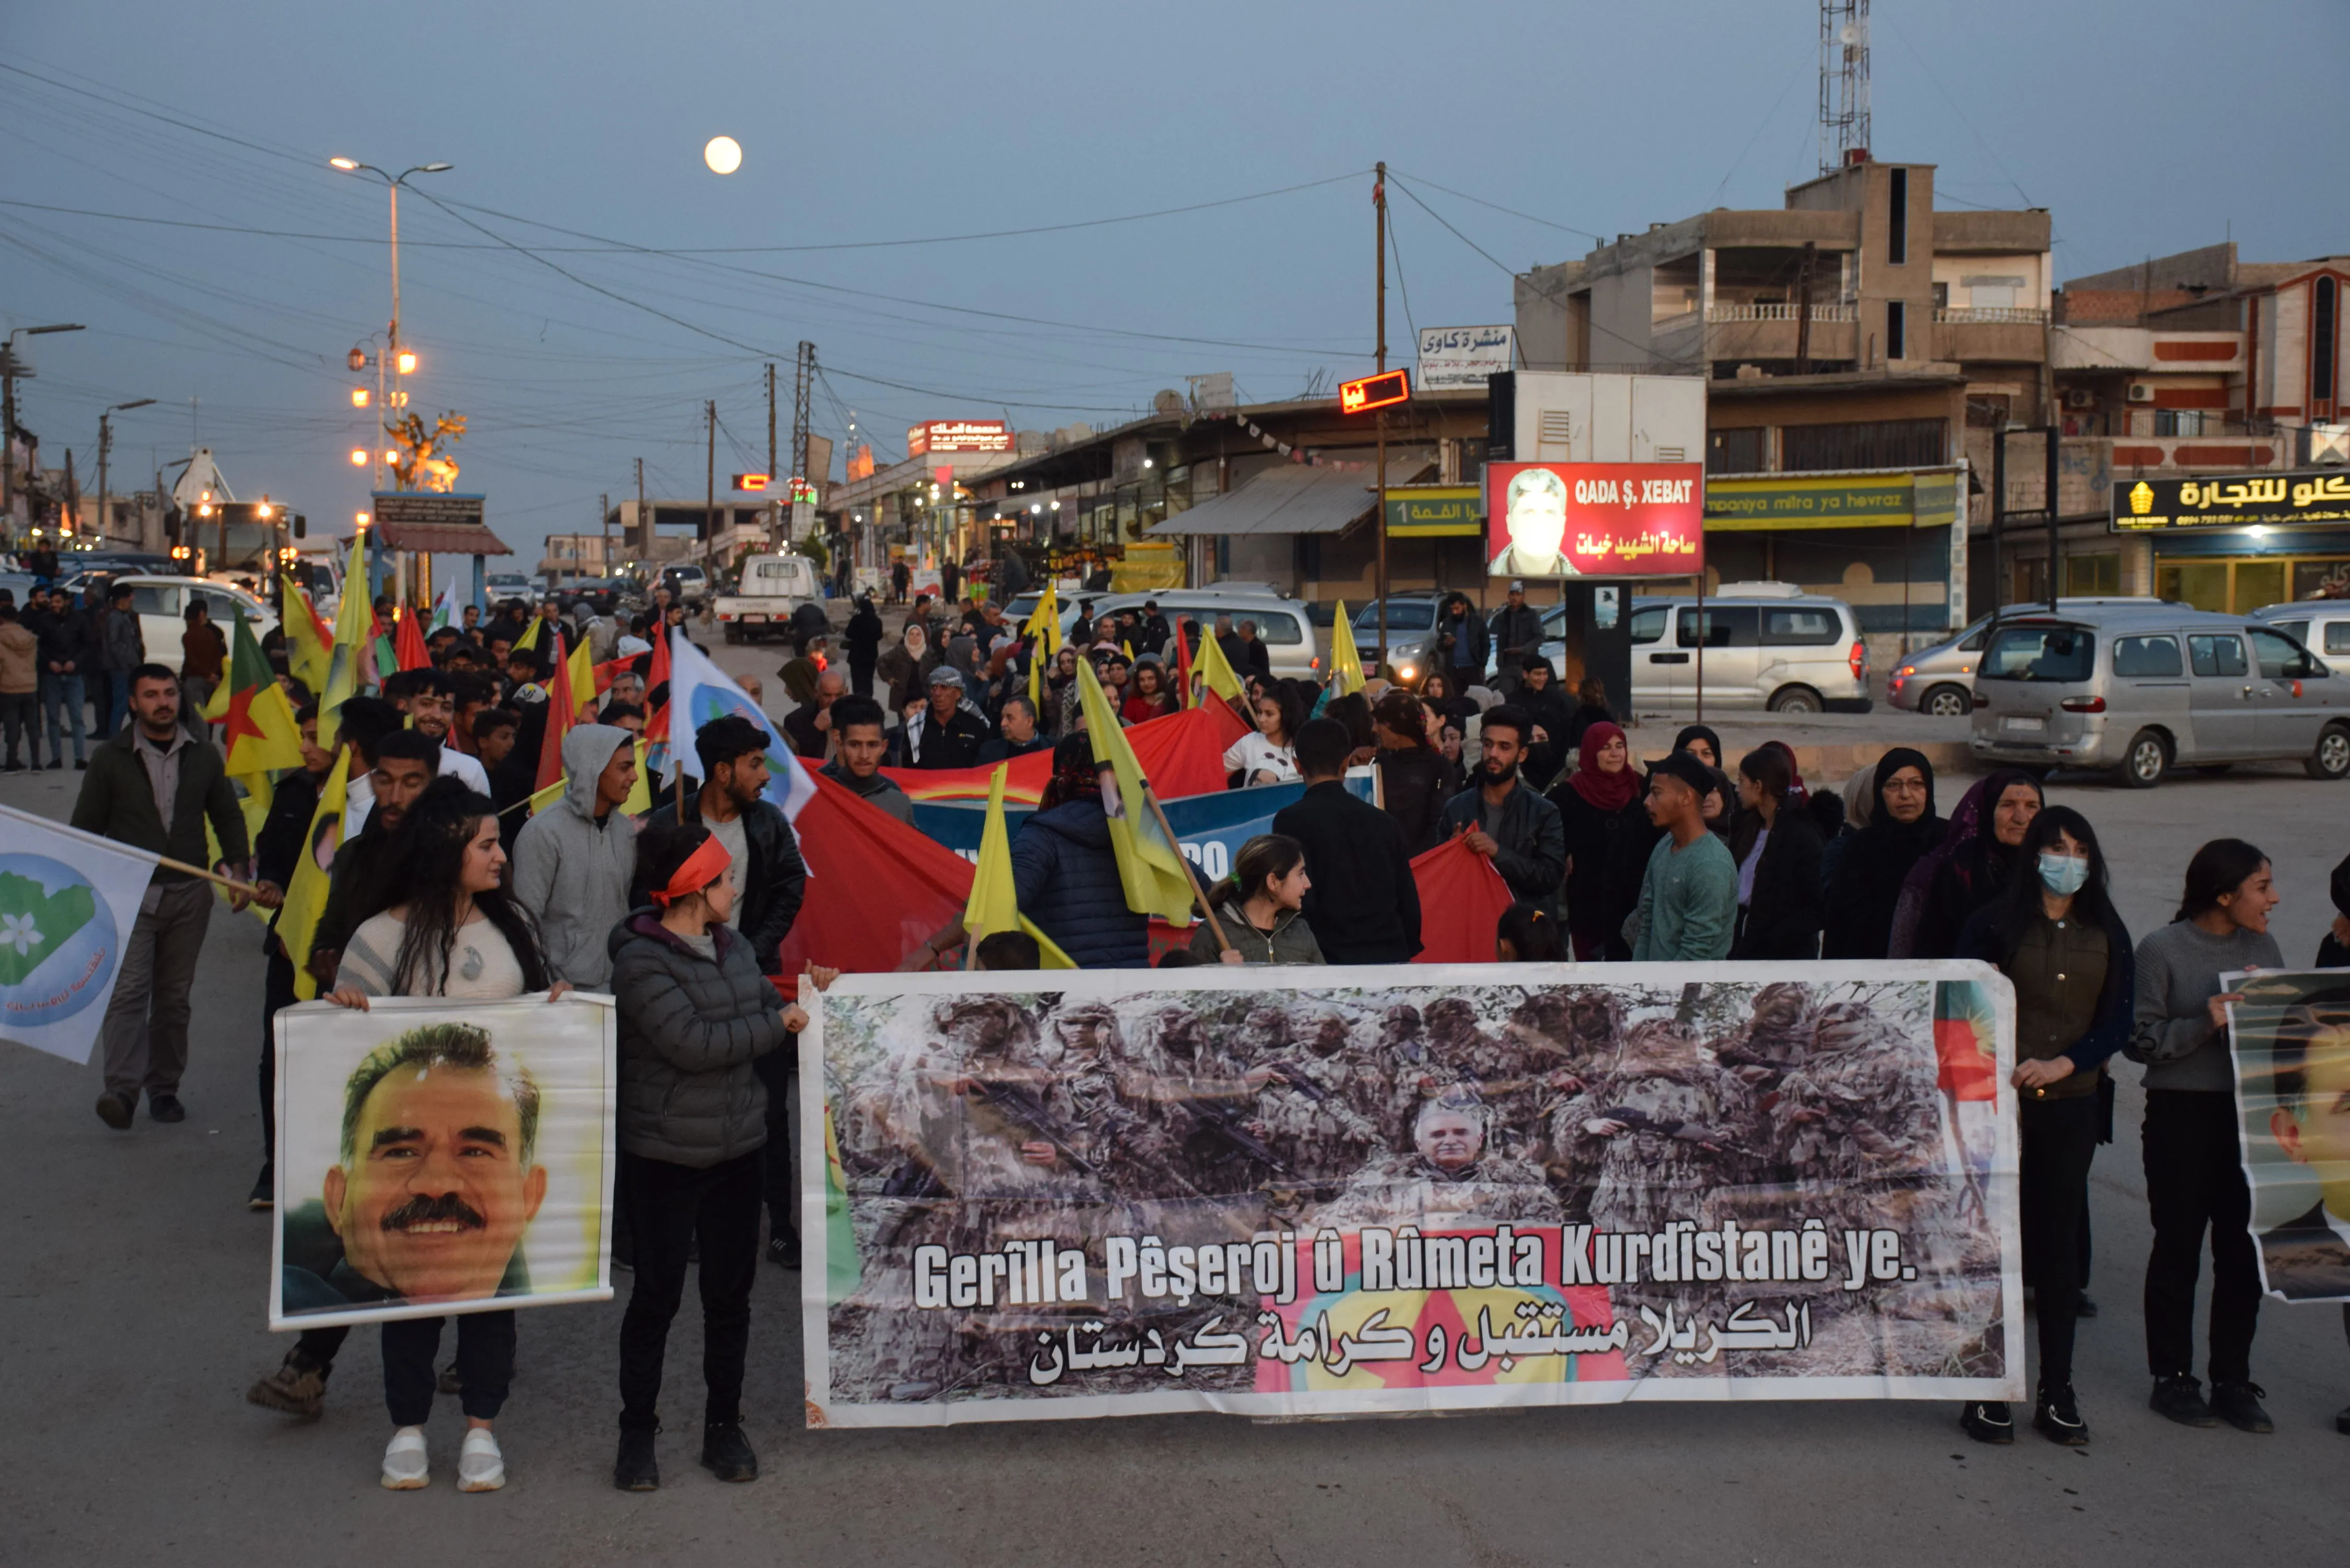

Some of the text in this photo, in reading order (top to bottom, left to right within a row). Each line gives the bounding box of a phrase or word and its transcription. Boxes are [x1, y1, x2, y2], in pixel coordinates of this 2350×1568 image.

[1575, 479, 1693, 510] QADA Ş. XEBAT
[1821, 496, 1840, 512] ya
[2180, 478, 2287, 509] للتجارة
[1576, 531, 1695, 560] ساحة الشهيد خبات
[913, 1218, 1917, 1308] Gerîlla Pêşeroj û Rûmeta Kurdîstanê ye.
[1028, 1299, 1814, 1387] الكريلا مستقبل و كرامة كردستان
